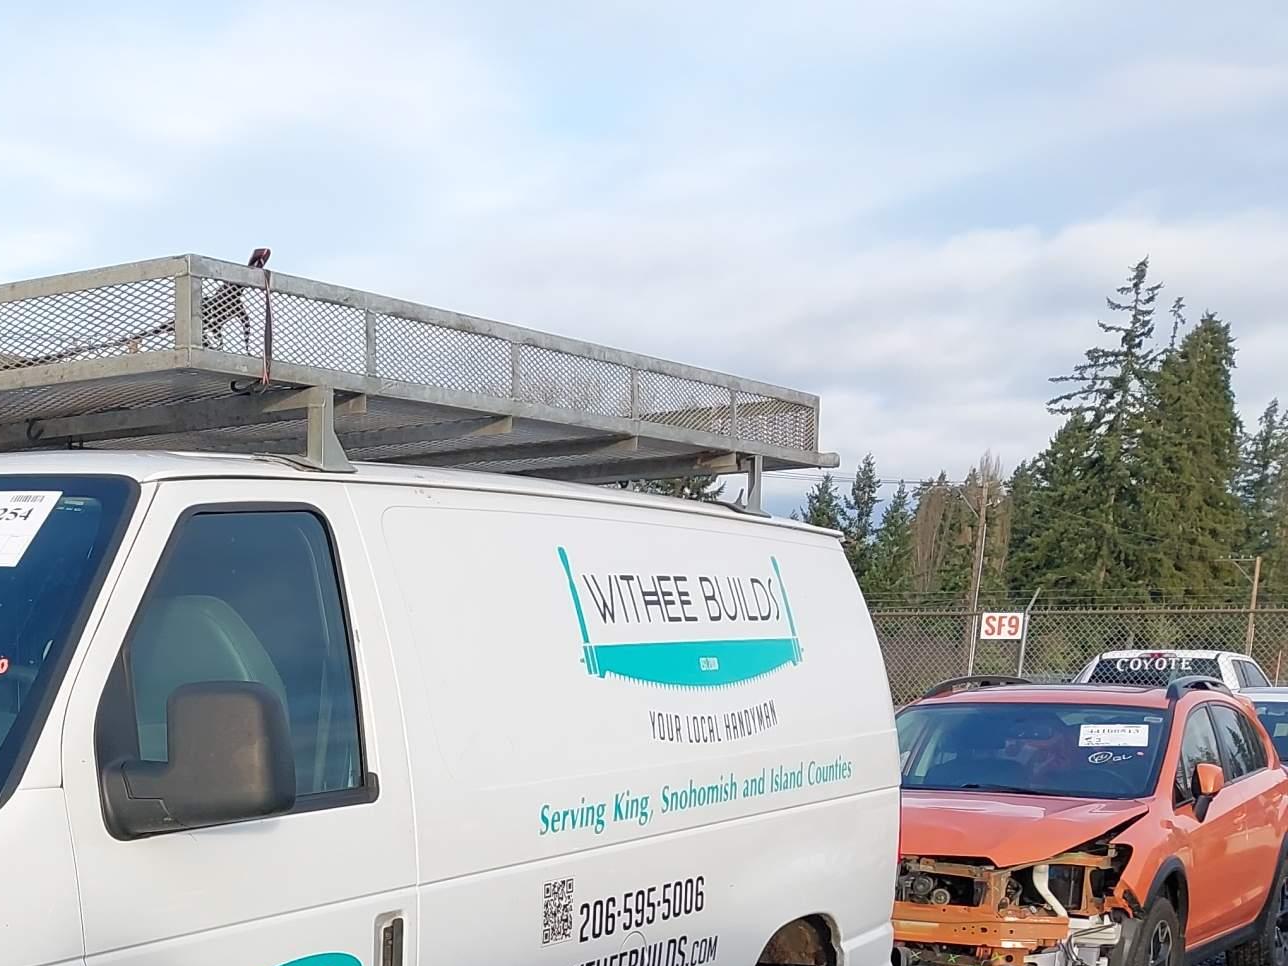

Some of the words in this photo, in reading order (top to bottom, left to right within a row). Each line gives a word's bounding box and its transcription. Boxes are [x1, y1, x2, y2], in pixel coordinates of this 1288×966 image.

[582, 574, 698, 624] WITHEE
[699, 575, 781, 622] BUILDS
[983, 615, 1021, 637] SF9
[1115, 656, 1194, 673] COYOTE
[648, 709, 683, 743] YOUR
[685, 715, 722, 744] LOCAL
[723, 699, 779, 742] HANDYMAN
[538, 797, 606, 836] Serving
[612, 790, 655, 827] King,
[661, 772, 738, 814] Snohomish
[742, 768, 766, 799] and
[769, 762, 804, 792] Island
[807, 754, 853, 786] Counties
